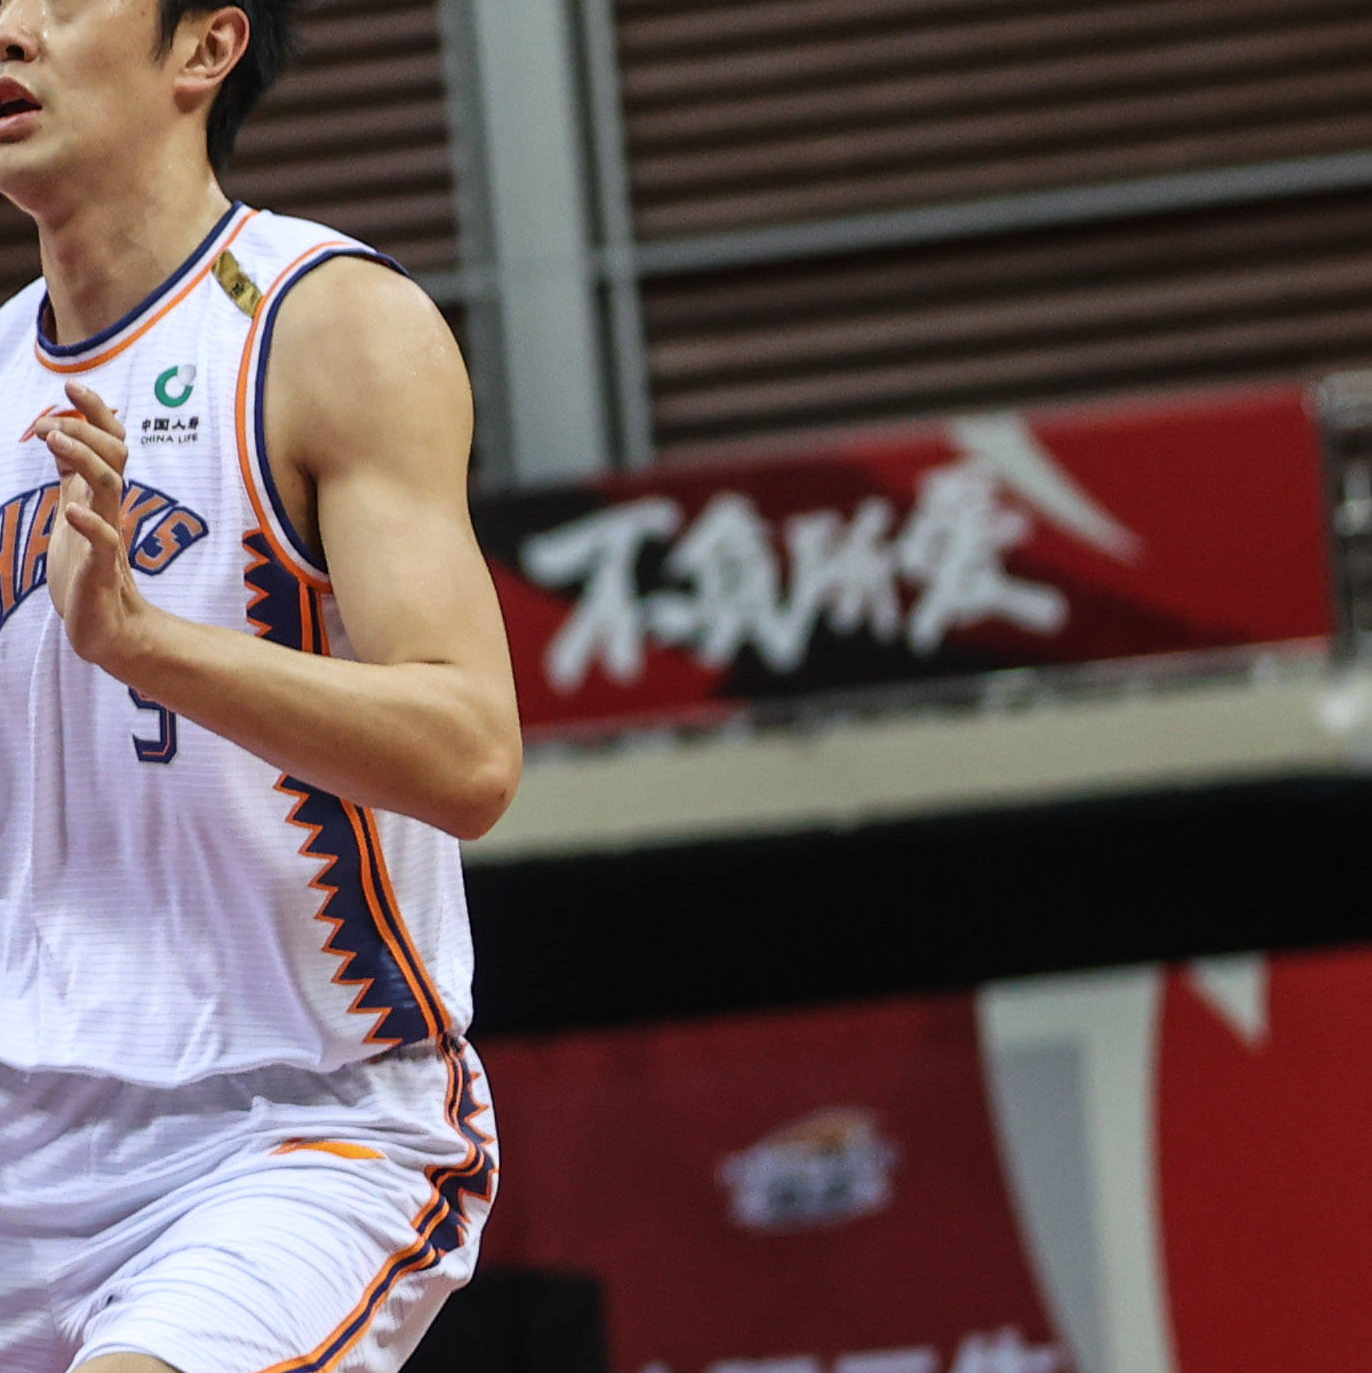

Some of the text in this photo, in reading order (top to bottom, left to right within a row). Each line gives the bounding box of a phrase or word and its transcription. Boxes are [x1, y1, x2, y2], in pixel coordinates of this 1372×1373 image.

[141, 416, 200, 433] 中国人寿
[141, 432, 199, 445] CHINA LIFE
